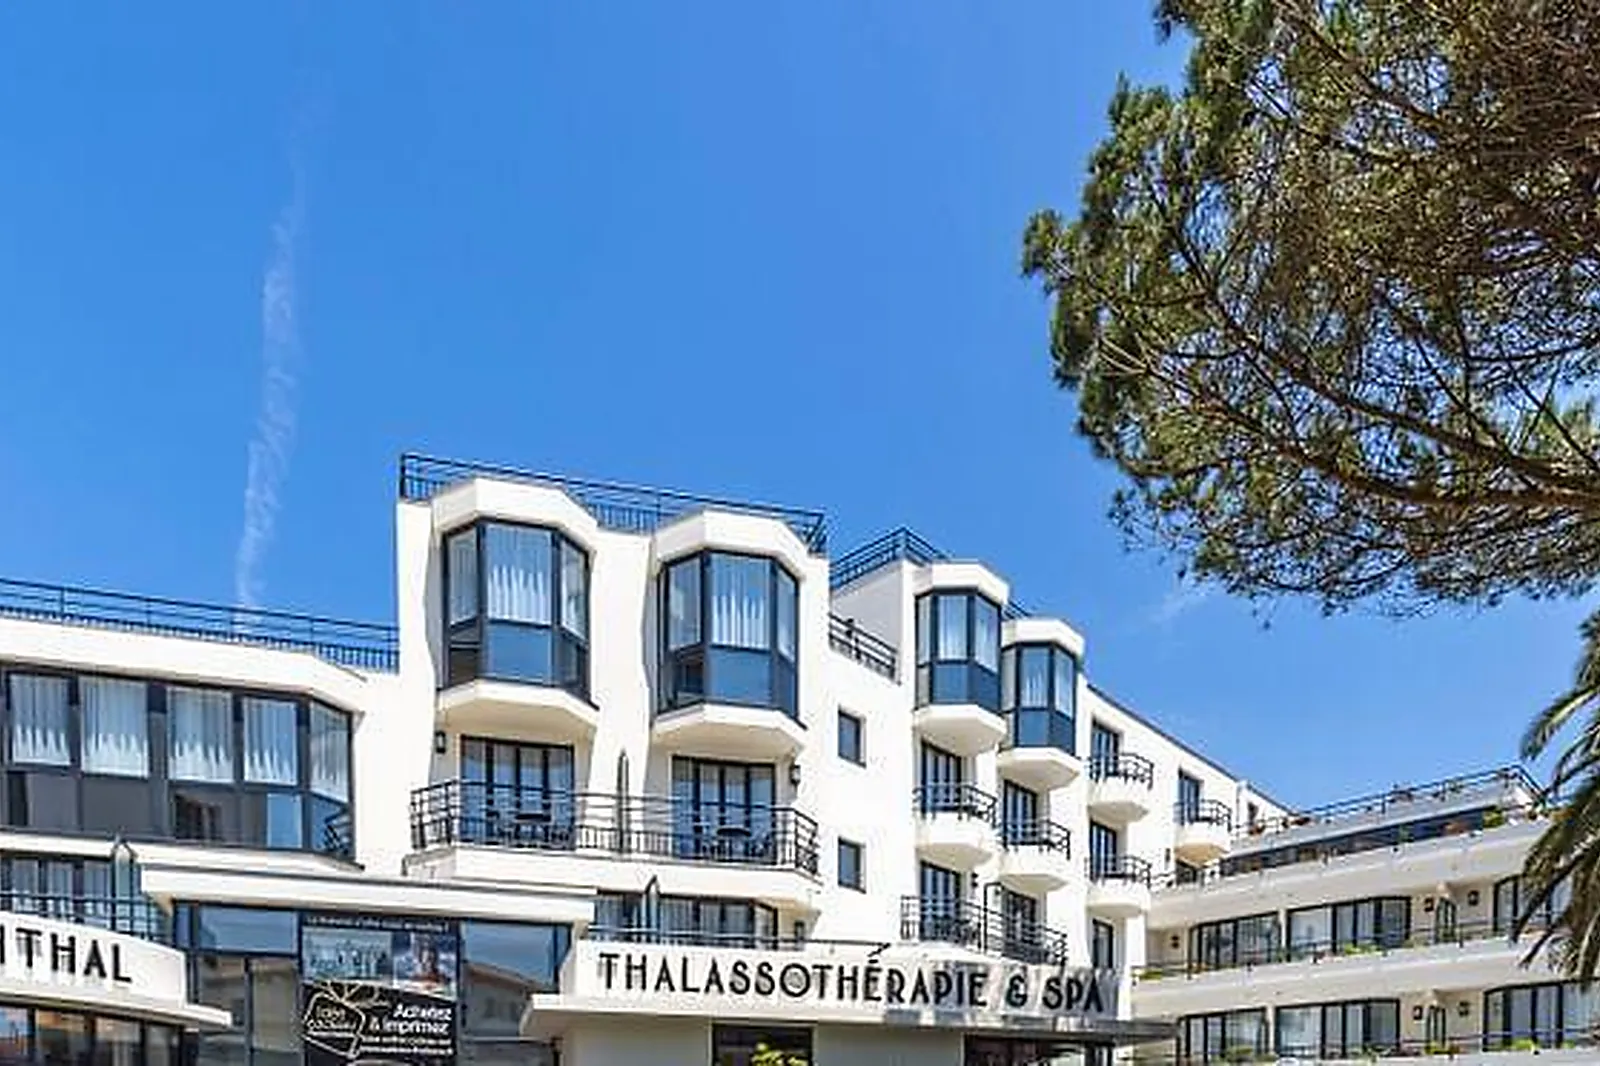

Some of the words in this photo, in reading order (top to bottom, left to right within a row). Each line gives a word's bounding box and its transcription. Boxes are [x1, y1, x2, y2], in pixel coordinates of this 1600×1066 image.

[599, 944, 987, 1007] THALASSOTHÉRAPIE
[1005, 971, 1028, 1008] &
[1041, 970, 1103, 1013] SPA
